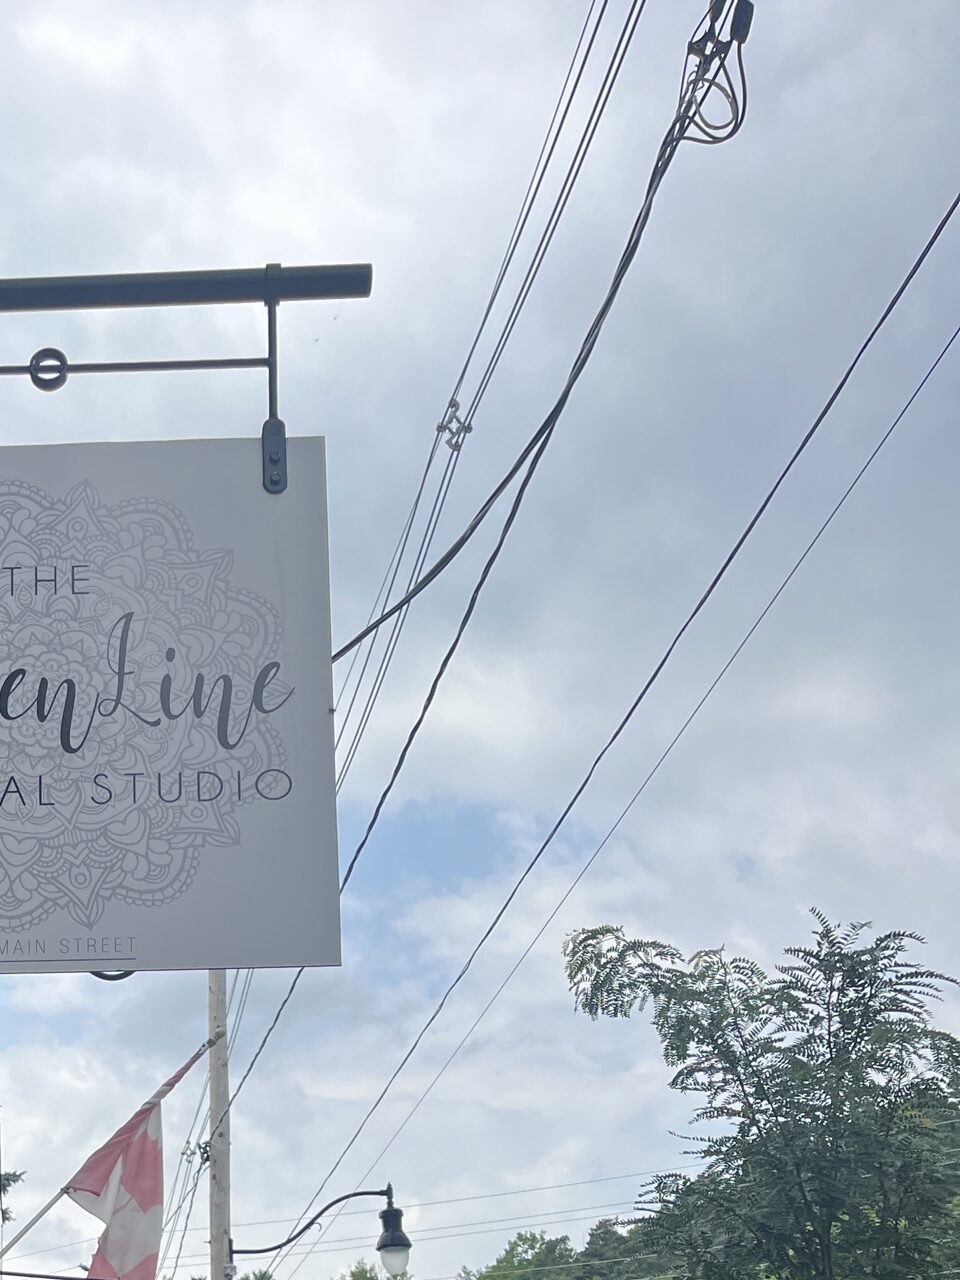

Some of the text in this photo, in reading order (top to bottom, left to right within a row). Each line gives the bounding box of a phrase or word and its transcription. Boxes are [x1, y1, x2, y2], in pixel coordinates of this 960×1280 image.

[2, 565, 91, 597] THE
[97, 611, 296, 750] Line
[90, 768, 293, 805] STUDIO
[58, 935, 137, 955] STREET
